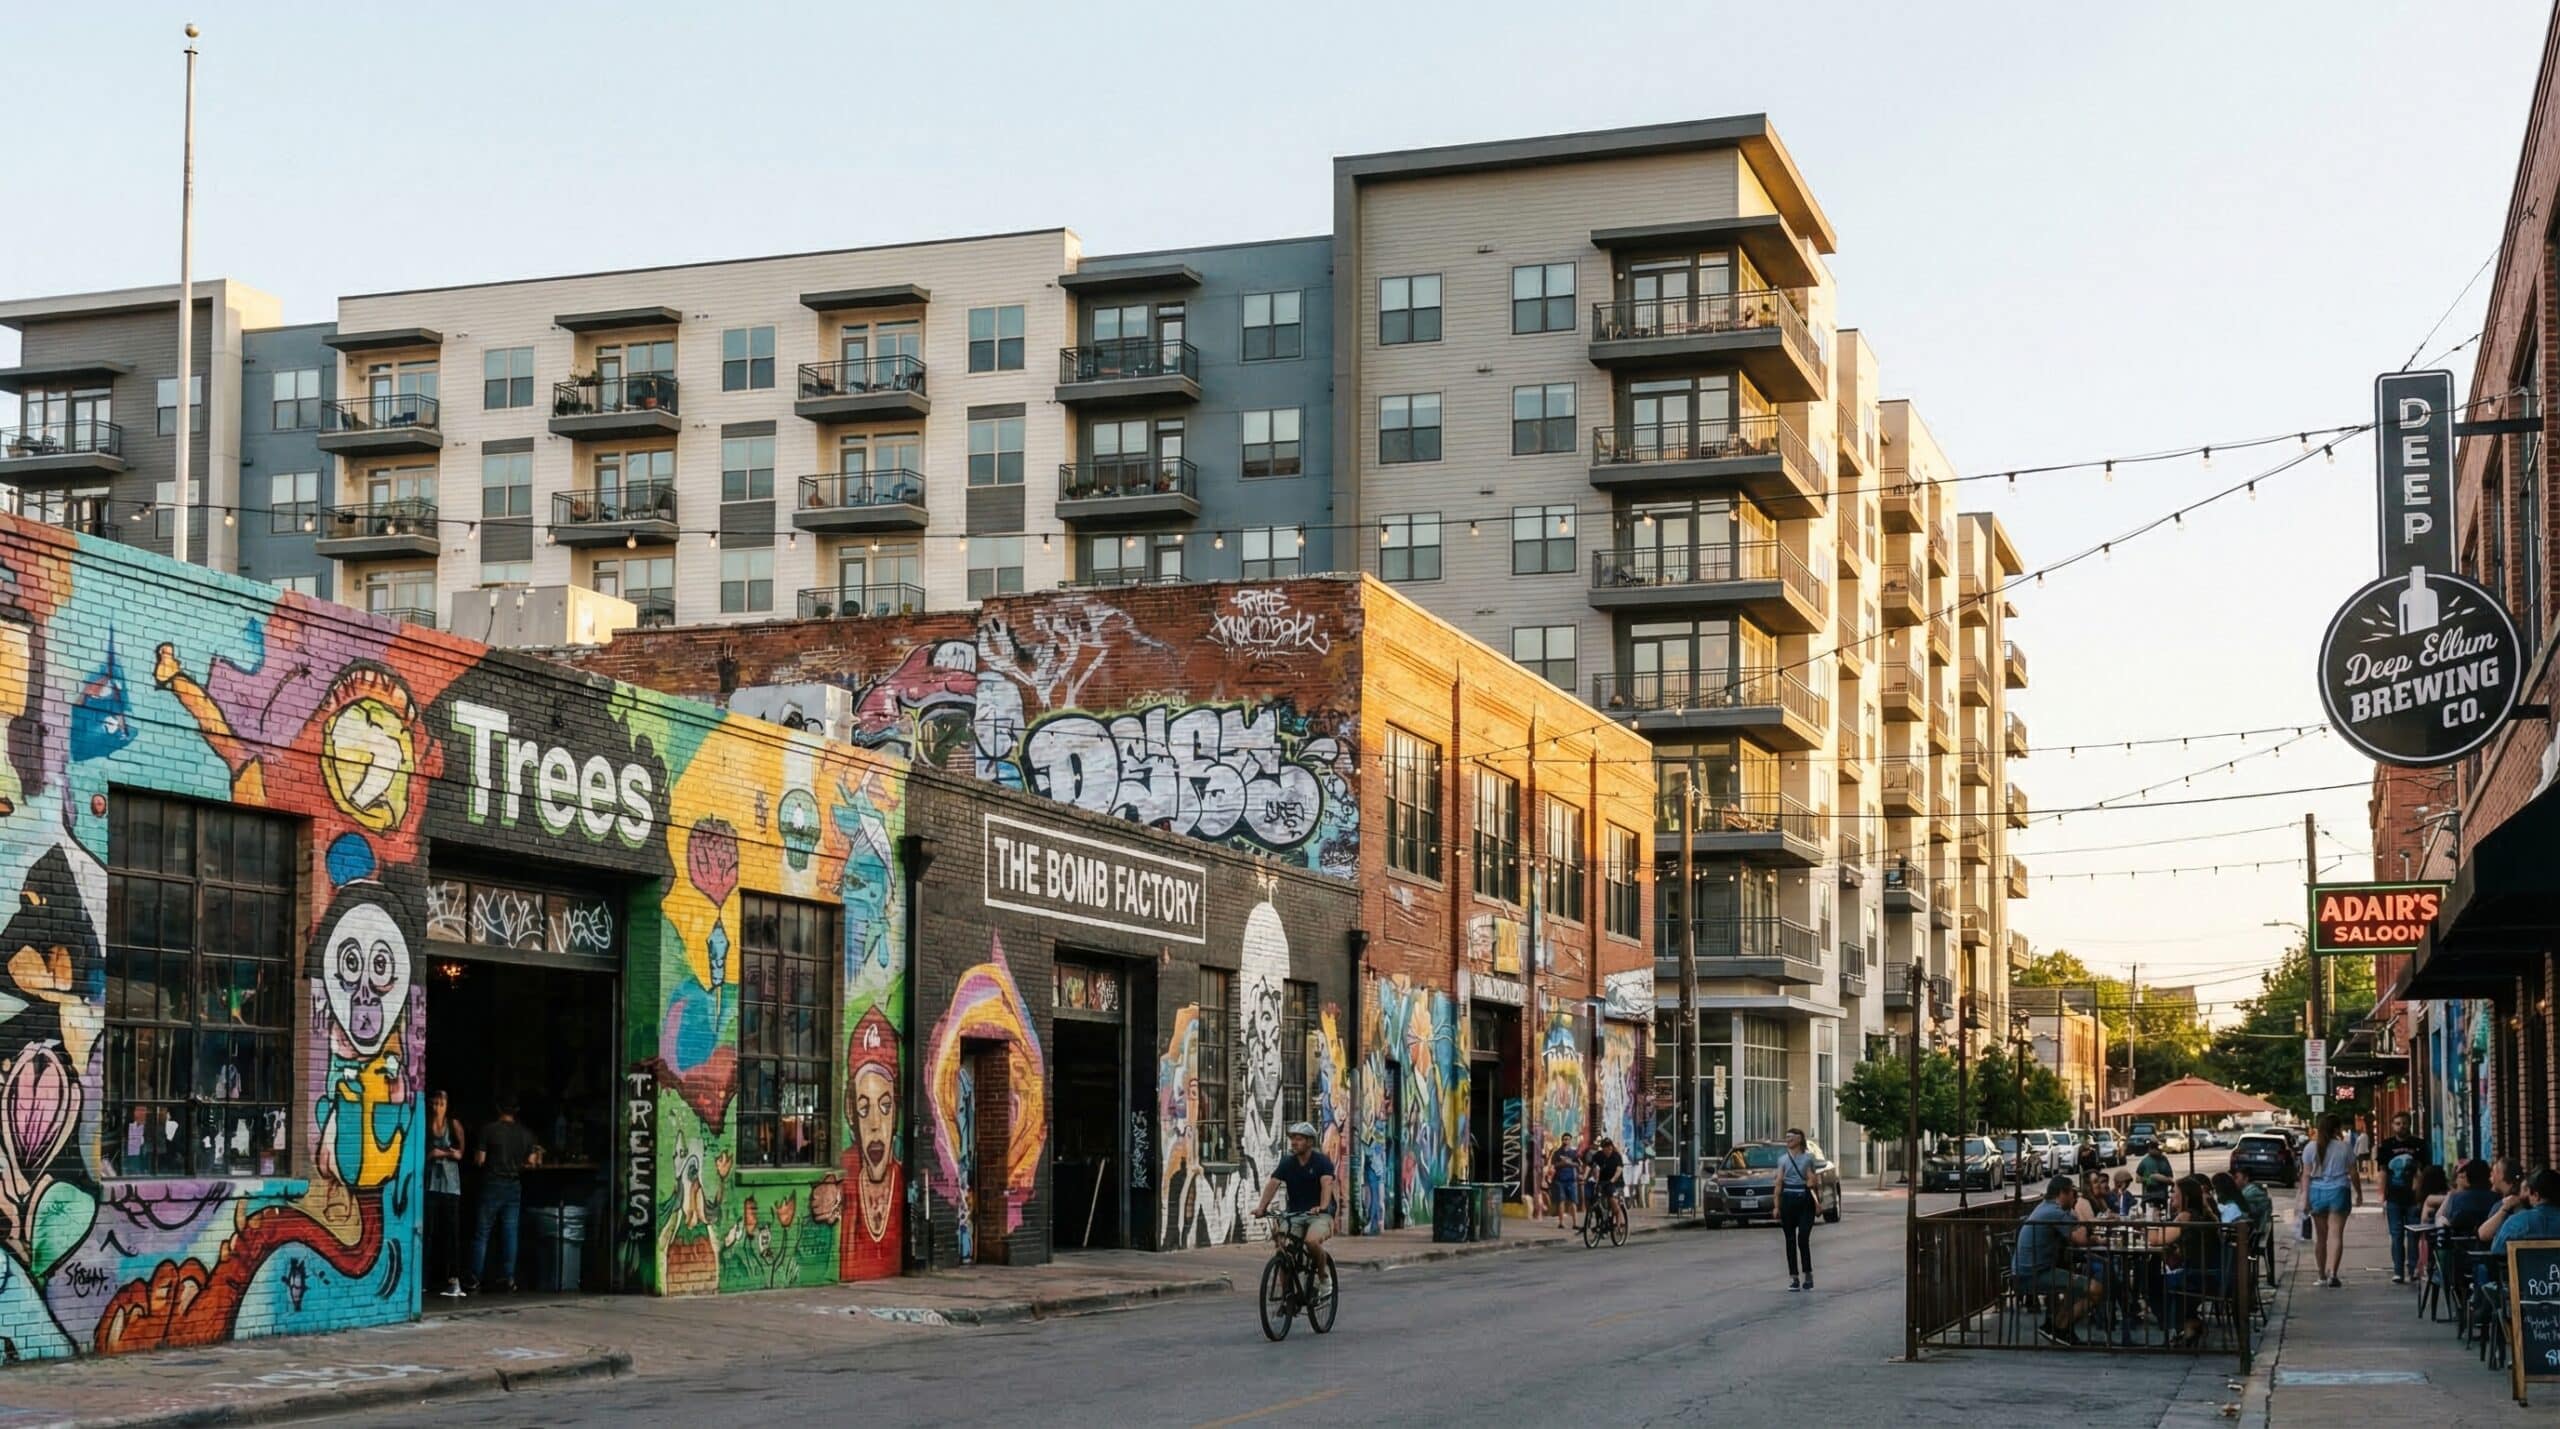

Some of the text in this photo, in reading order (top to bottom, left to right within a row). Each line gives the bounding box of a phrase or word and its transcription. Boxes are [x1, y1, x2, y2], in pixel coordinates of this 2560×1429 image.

[2399, 397, 2433, 545] DEEP
[2344, 625, 2499, 687] Deep Ellum
[2351, 656, 2500, 724] BREWING
[2442, 697, 2486, 729] CO.
[452, 700, 655, 846] Trees
[994, 836, 1200, 926] THE BOMB FACTORY
[2320, 893, 2439, 922] ADAIR'S
[2334, 925, 2425, 942] SALOON
[627, 1073, 653, 1228] TREES
